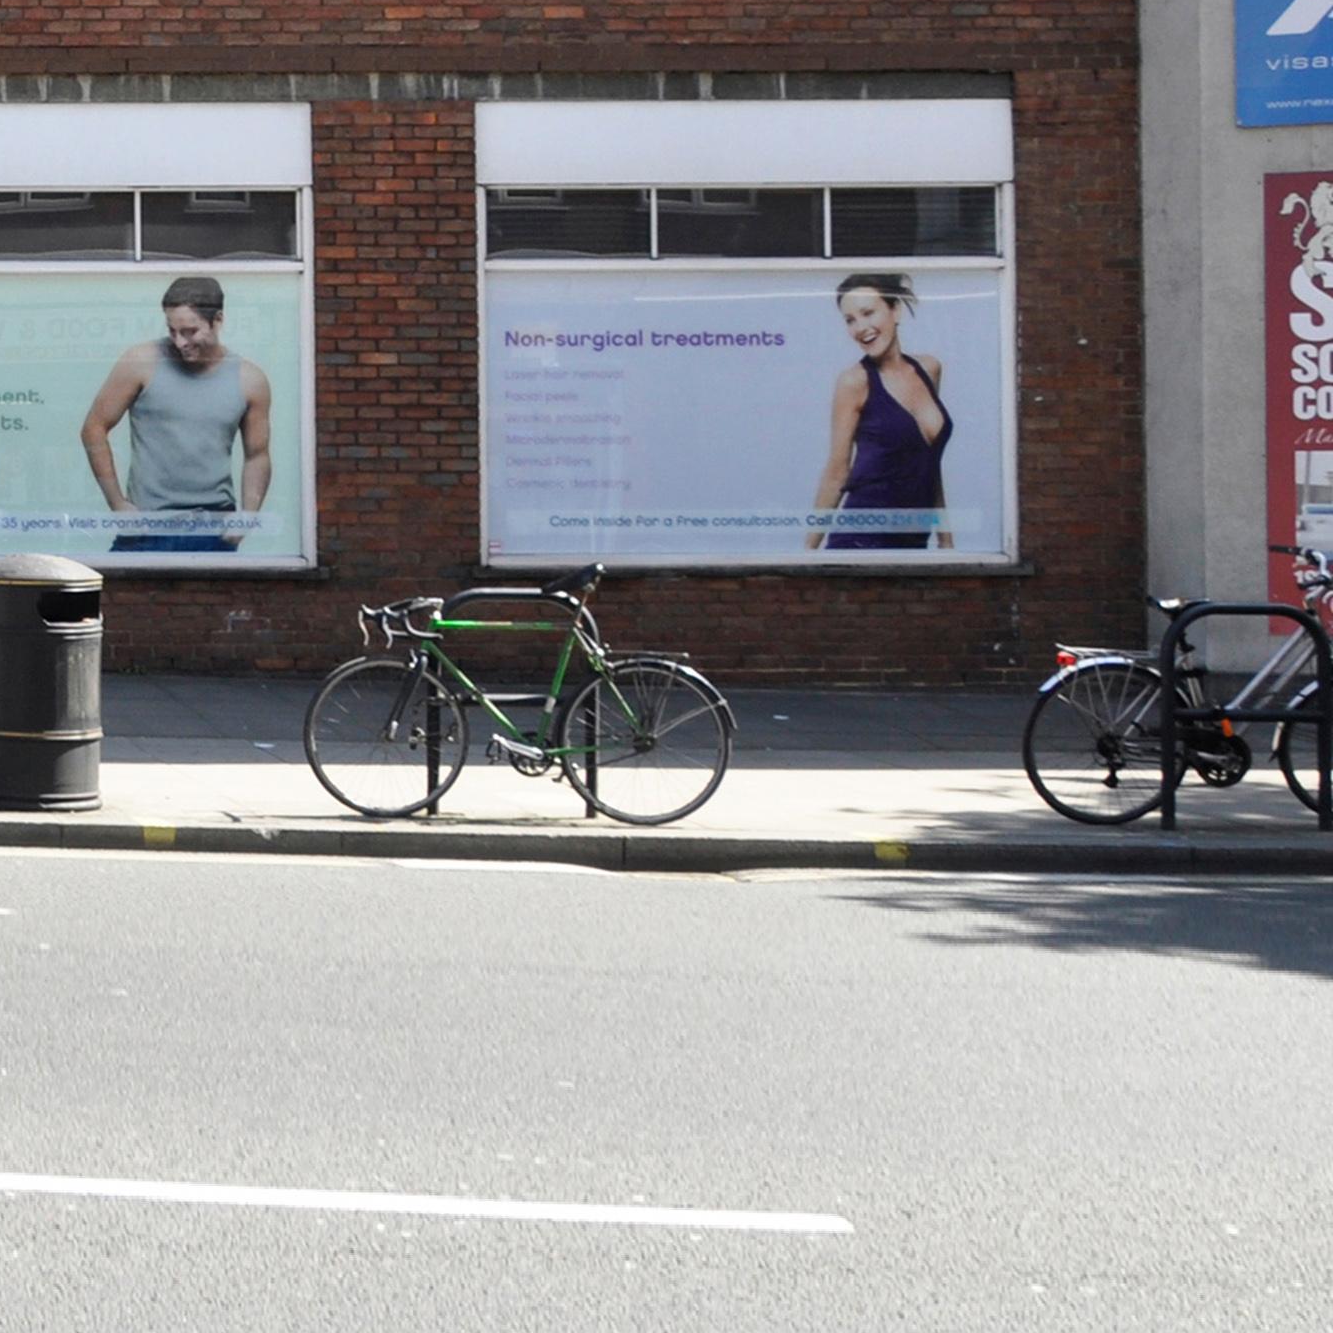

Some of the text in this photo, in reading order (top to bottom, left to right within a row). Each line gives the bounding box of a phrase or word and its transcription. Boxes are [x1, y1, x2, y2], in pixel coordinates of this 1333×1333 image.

[1265, 53, 1333, 71] visa
[504, 330, 785, 351] Non-surgical treatments
[1, 518, 18, 529] 35
[68, 518, 97, 530] Visit
[550, 515, 589, 527] Come
[593, 515, 632, 527] inside
[663, 518, 673, 527] a
[711, 515, 801, 528] consultation.
[805, 514, 832, 526] Call
